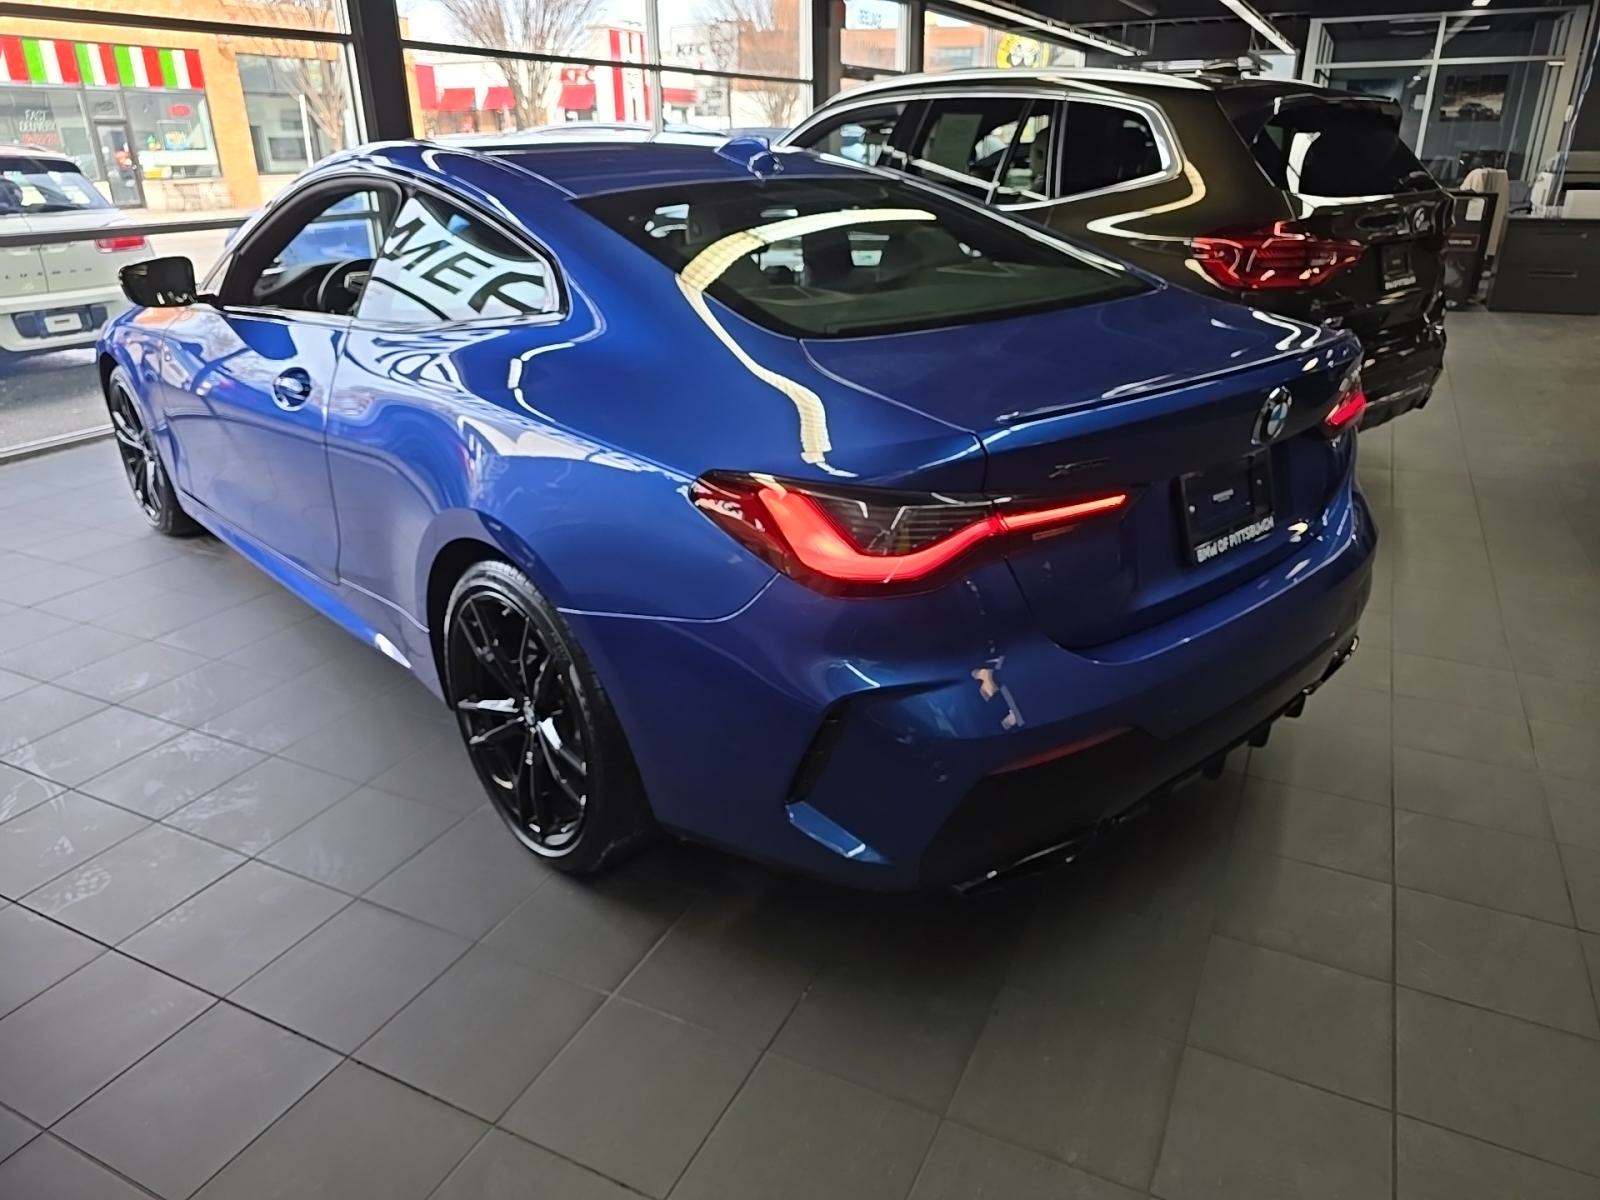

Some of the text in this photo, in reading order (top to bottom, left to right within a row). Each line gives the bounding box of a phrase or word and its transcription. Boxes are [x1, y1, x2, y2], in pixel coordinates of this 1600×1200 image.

[677, 43, 706, 57] KFC
[561, 67, 596, 82] KFC
[1217, 536, 1229, 552] OF
[1229, 516, 1274, 547] PITTSBURGH
